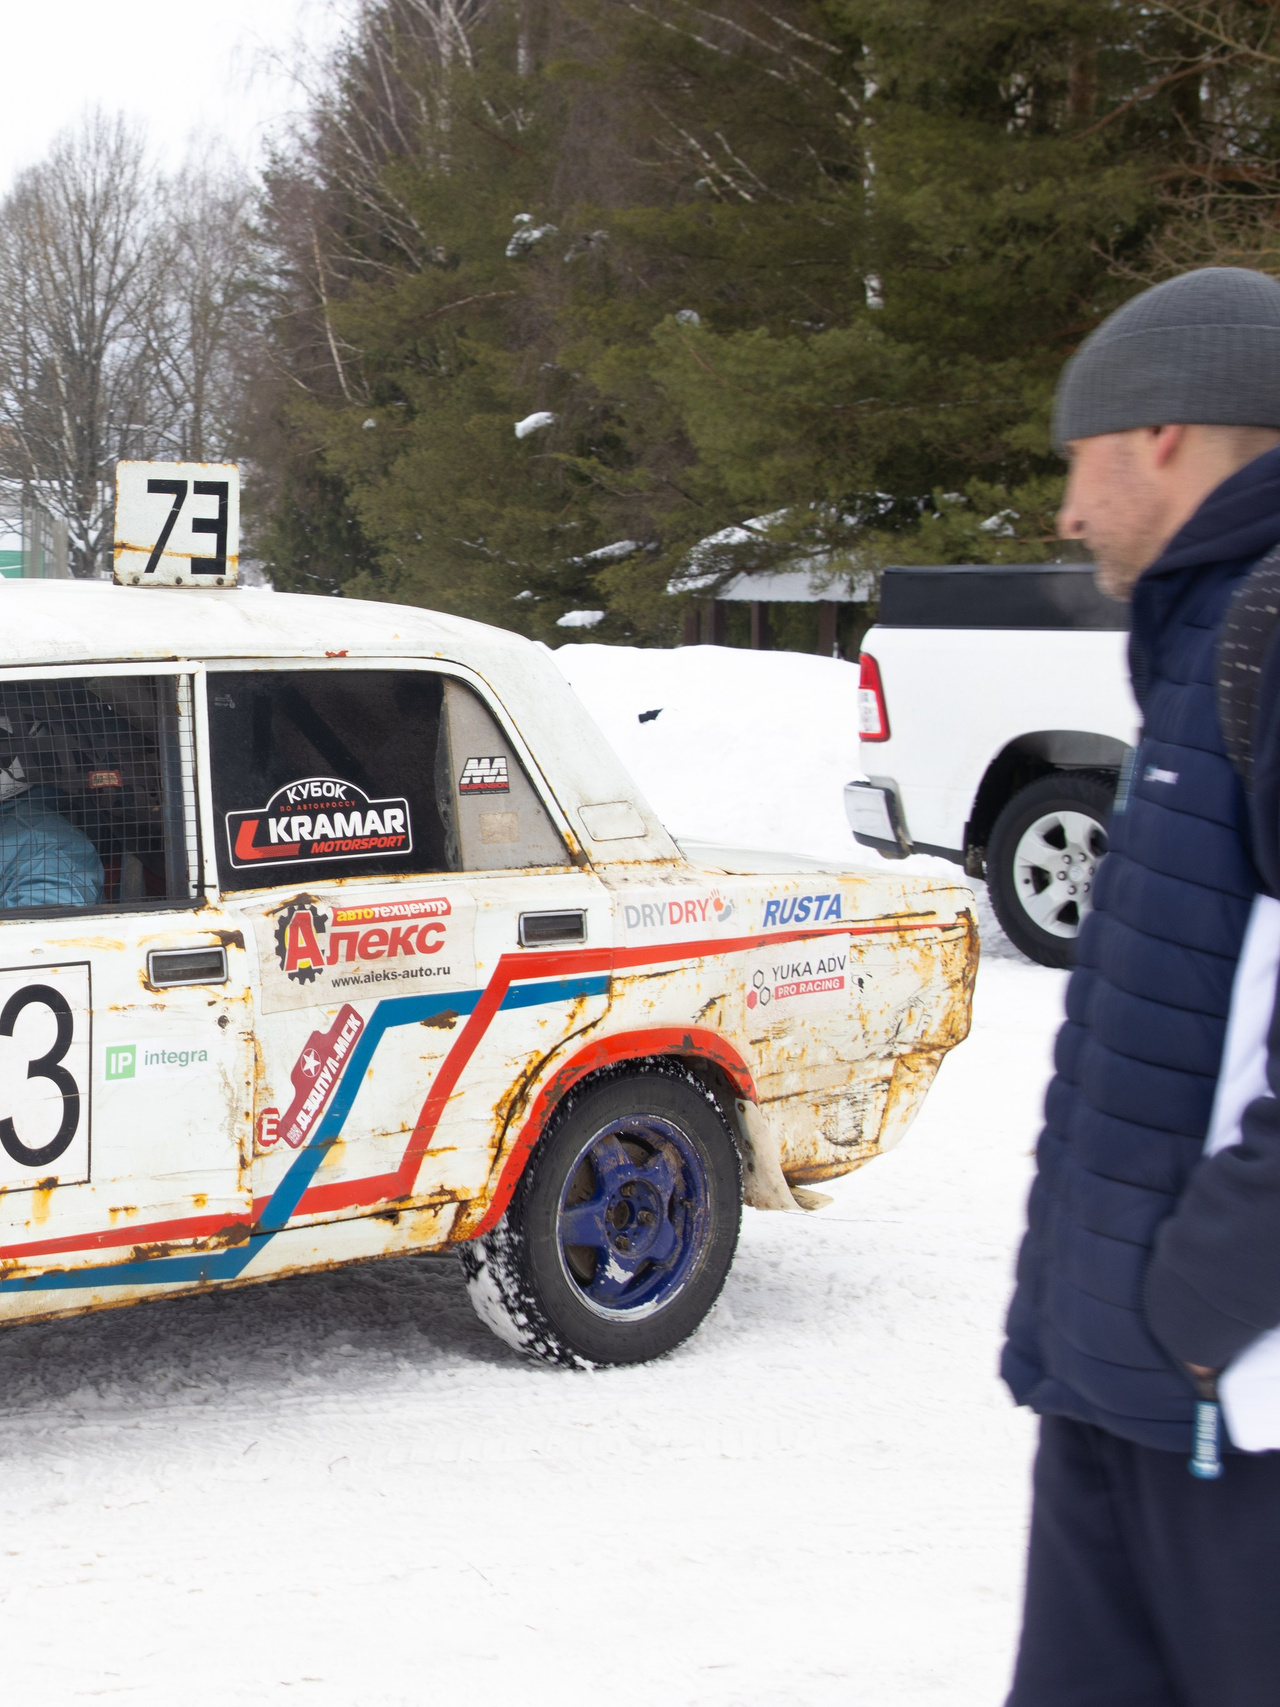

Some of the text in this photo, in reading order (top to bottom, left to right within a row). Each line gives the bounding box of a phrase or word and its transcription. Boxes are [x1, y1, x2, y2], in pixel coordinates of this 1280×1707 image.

[144, 479, 229, 575] 73
[286, 781, 348, 804] КУБОК
[460, 782, 509, 790] SUSPENSION
[297, 800, 356, 811] АВТОКРОССУ
[268, 808, 406, 844] KRAMAR
[310, 834, 406, 854] MOTORSPORT
[336, 900, 448, 923] автотехцентр
[624, 898, 710, 929] DRYDRY
[762, 893, 843, 928] RUSTA
[285, 911, 447, 972] Алекс
[772, 955, 847, 981] YUKA ADV
[778, 978, 840, 998] PRO RACING
[110, 1049, 208, 1075] IP integra
